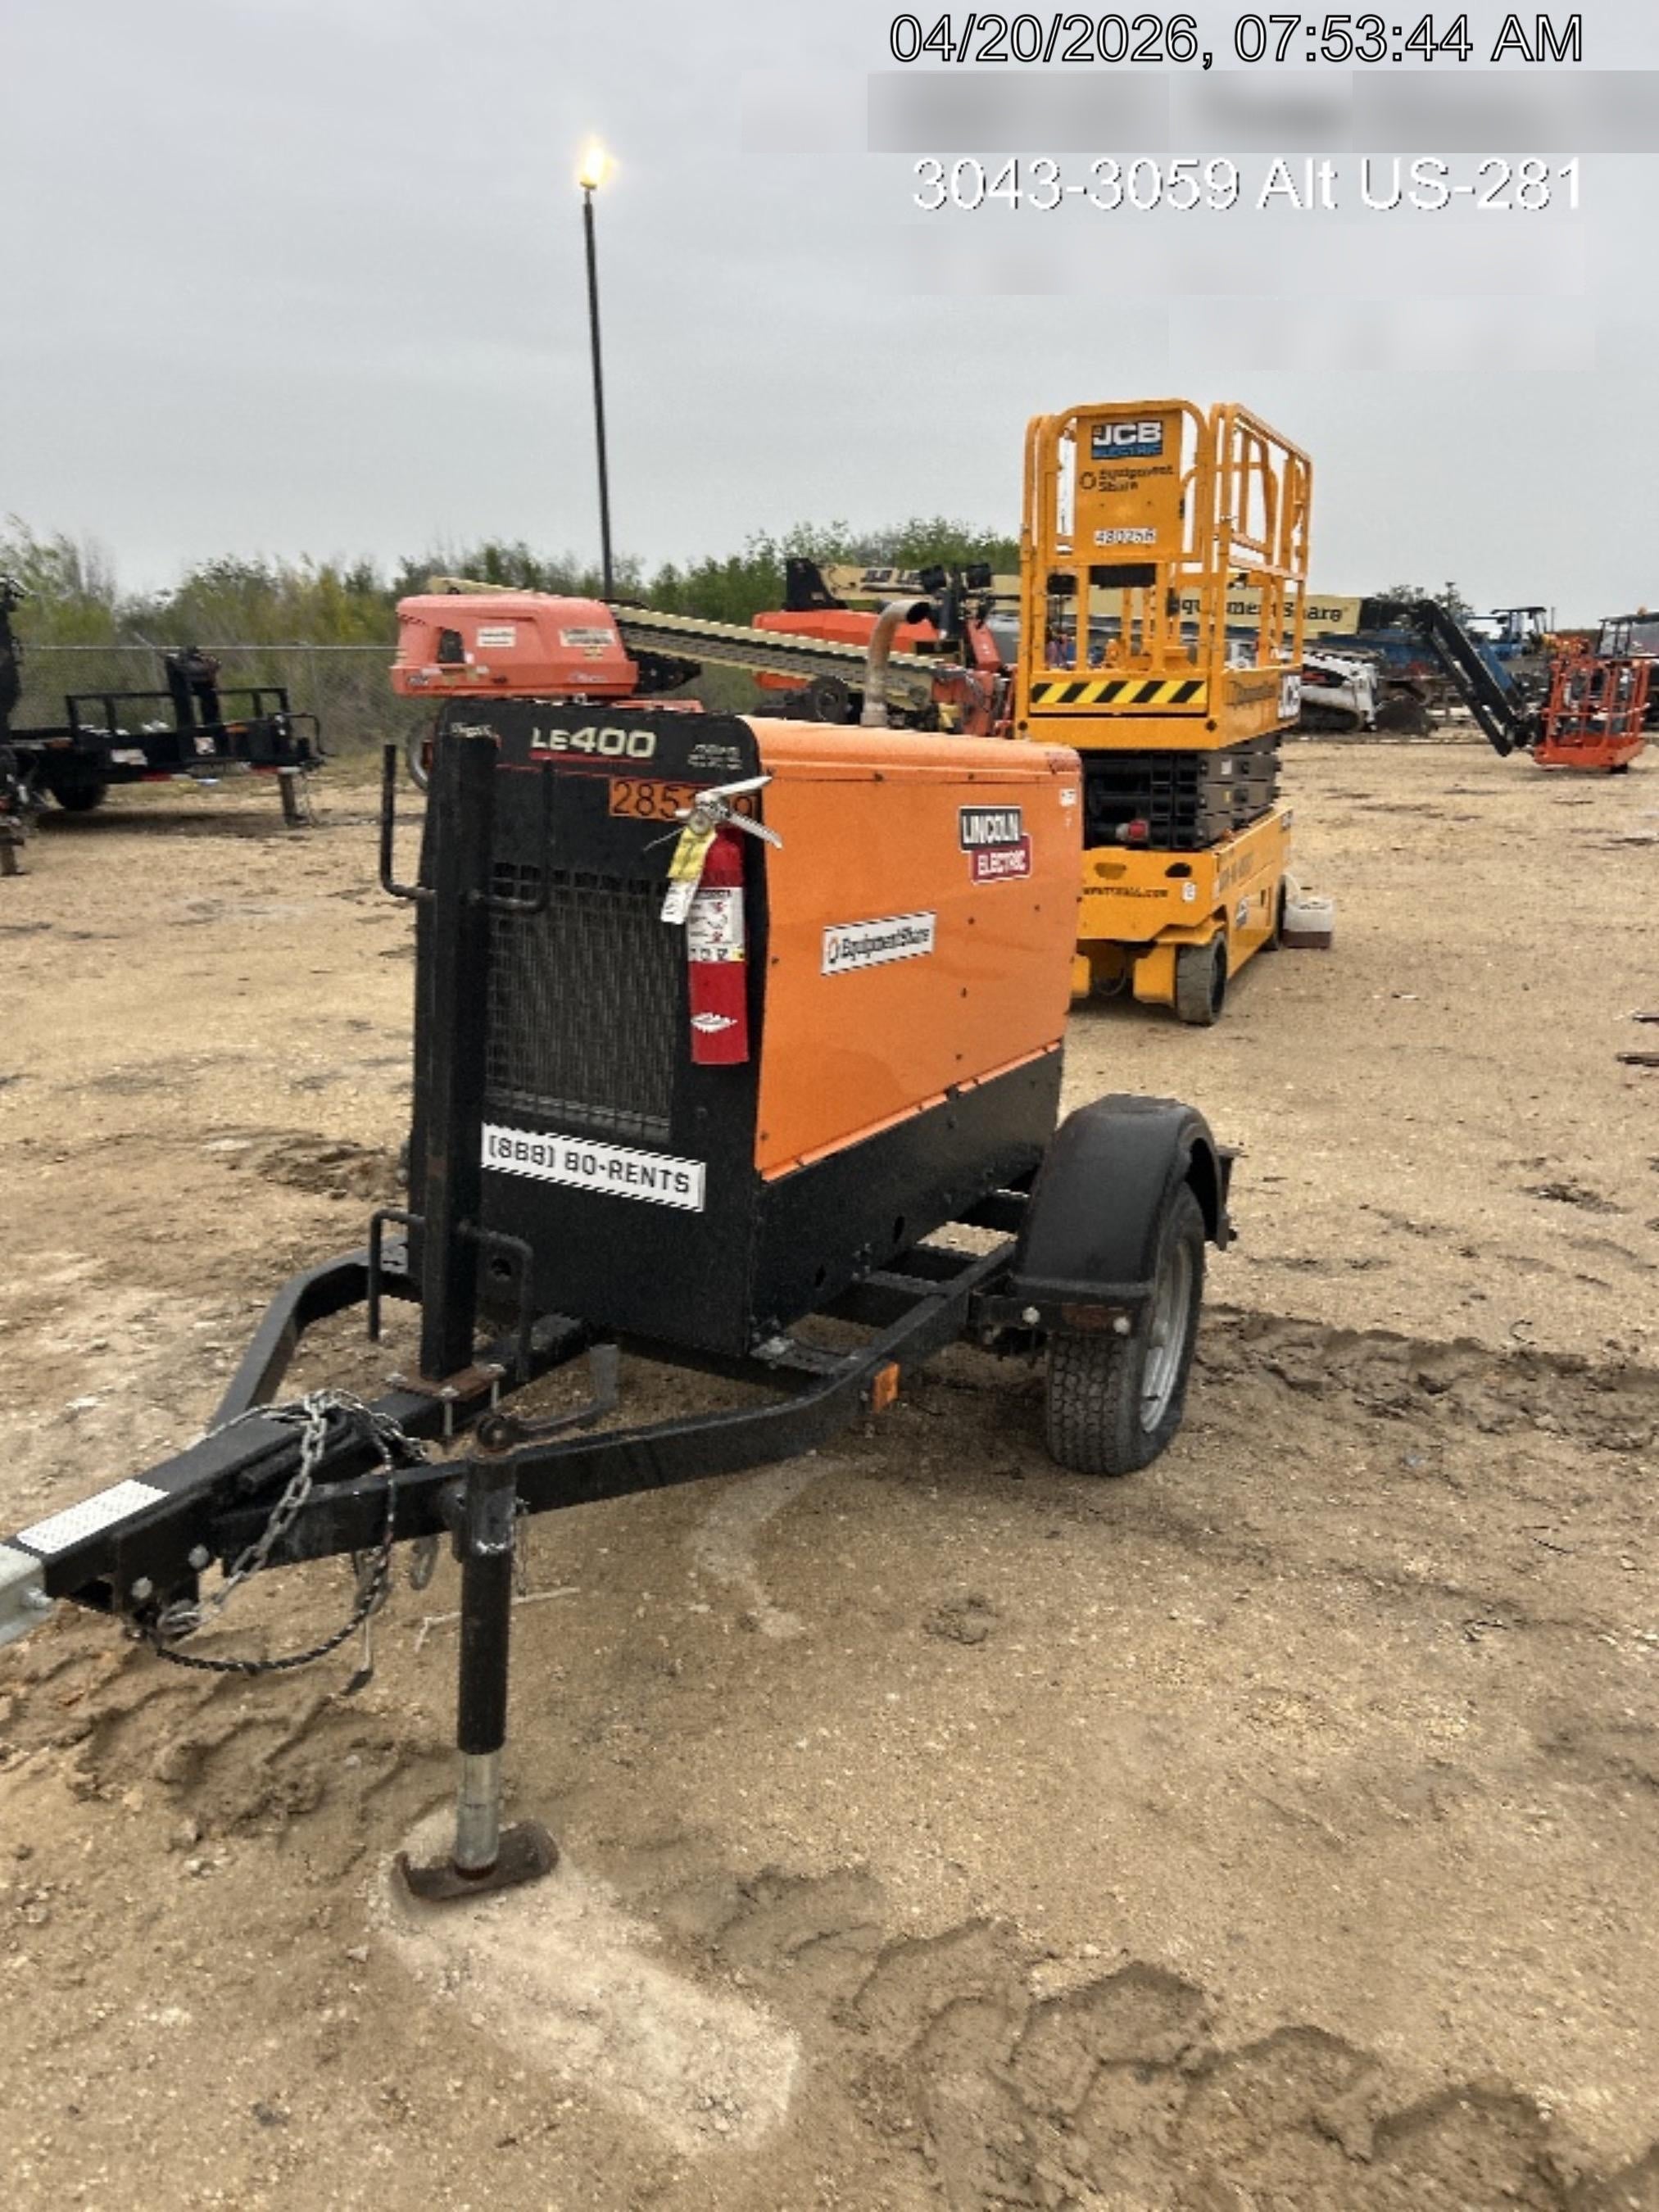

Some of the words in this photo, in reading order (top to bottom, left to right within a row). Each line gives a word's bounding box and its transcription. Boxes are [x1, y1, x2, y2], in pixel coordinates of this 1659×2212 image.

[1093, 421, 1162, 446] JCB
[1099, 465, 1173, 482] Equipment
[531, 726, 656, 758] LE400
[962, 812, 1019, 844] LINCOLN
[977, 849, 1027, 876] ELECTRIC
[841, 926, 930, 962] EquipmentShare
